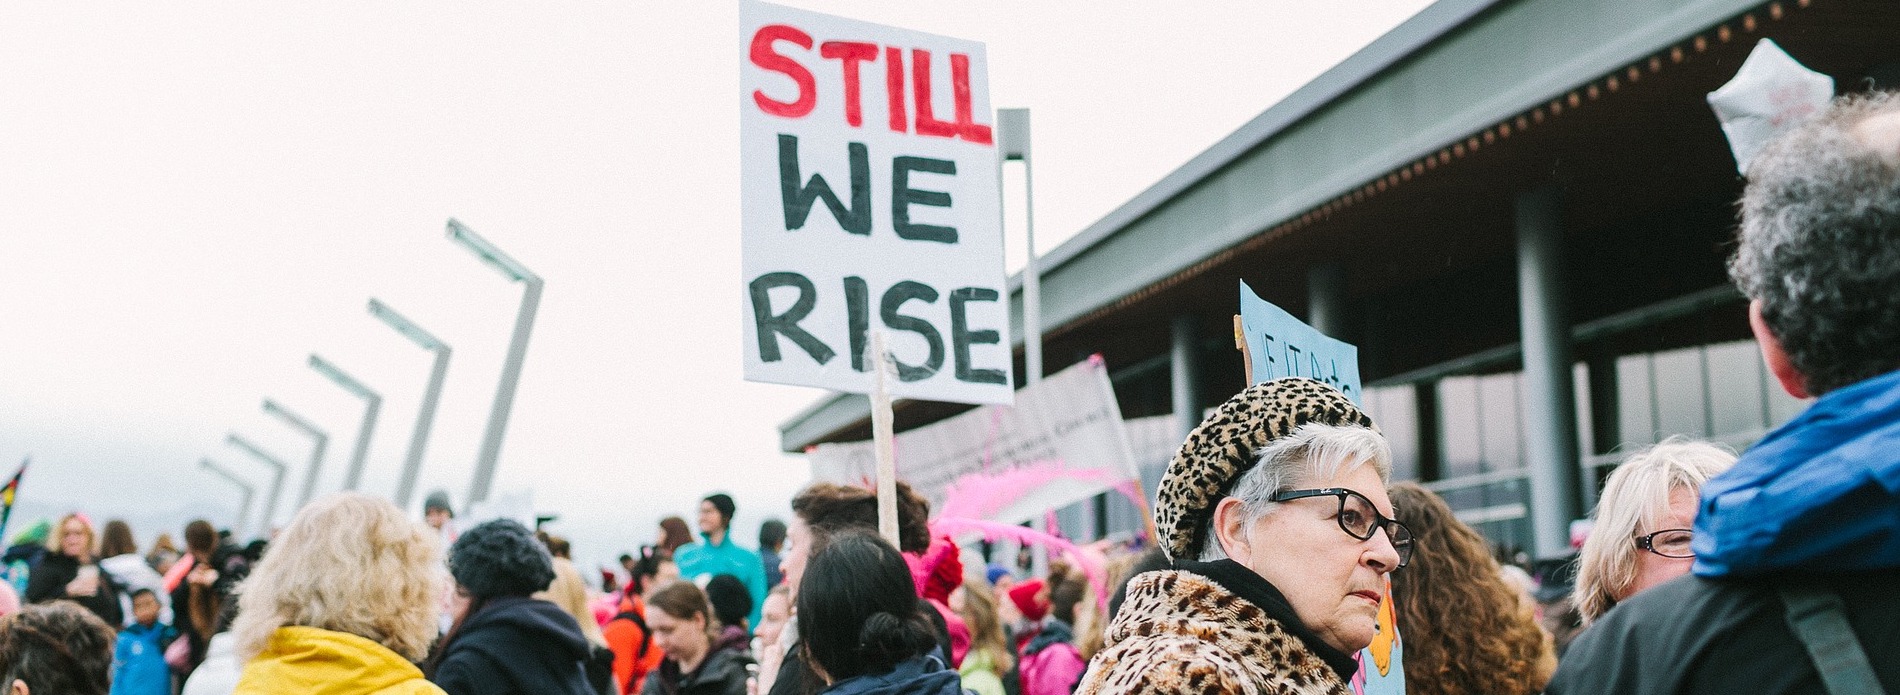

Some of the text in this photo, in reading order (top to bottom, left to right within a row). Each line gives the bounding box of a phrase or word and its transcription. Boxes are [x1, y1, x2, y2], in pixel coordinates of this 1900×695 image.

[749, 24, 993, 145] STILL
[778, 133, 959, 244] WE
[749, 271, 1008, 385] RISE
